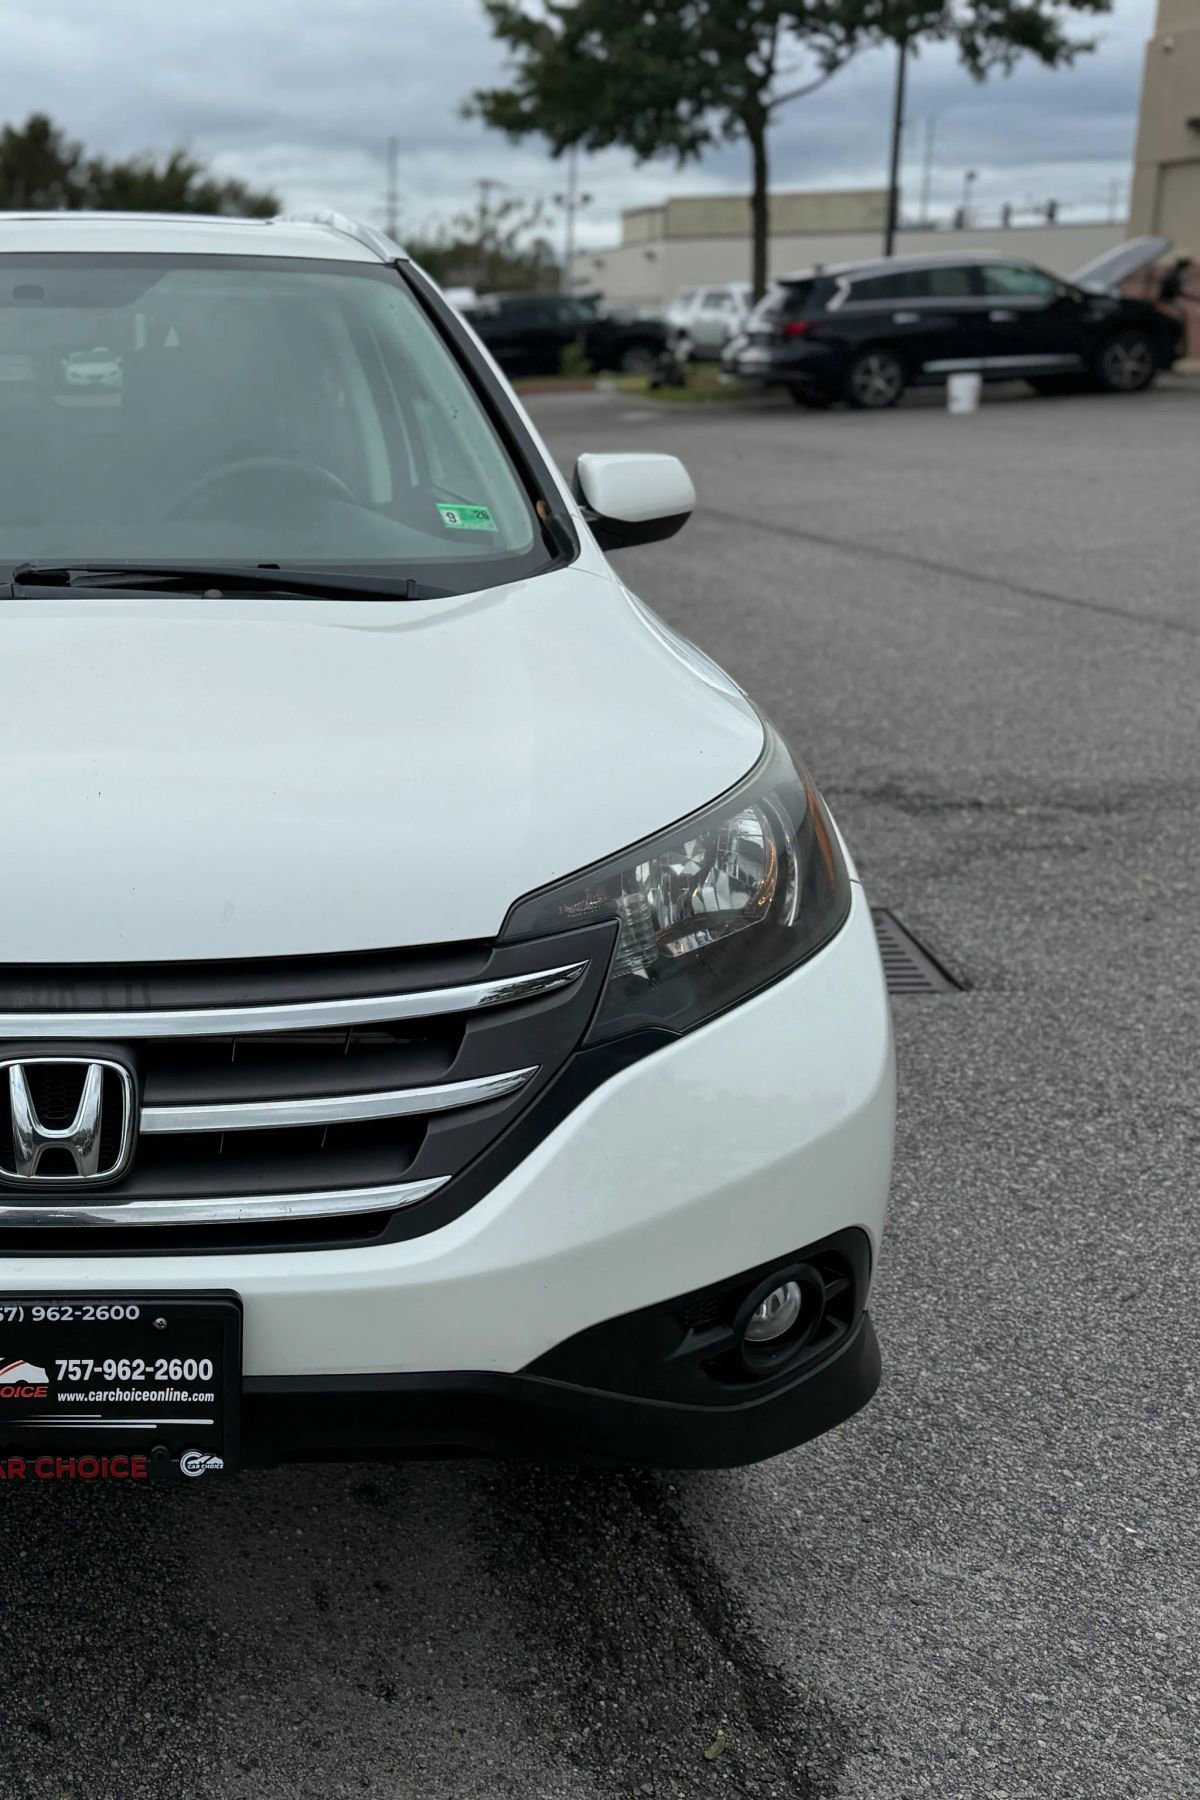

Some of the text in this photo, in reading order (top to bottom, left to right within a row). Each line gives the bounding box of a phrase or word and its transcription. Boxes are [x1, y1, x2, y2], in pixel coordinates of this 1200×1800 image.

[446, 511, 457, 523] 9
[31, 1304, 141, 1322] 962-2600
[55, 1358, 214, 1382] 757-962-2600
[57, 1388, 215, 1402] www.carchoiceonline.com
[34, 1457, 148, 1479] CHOICE
